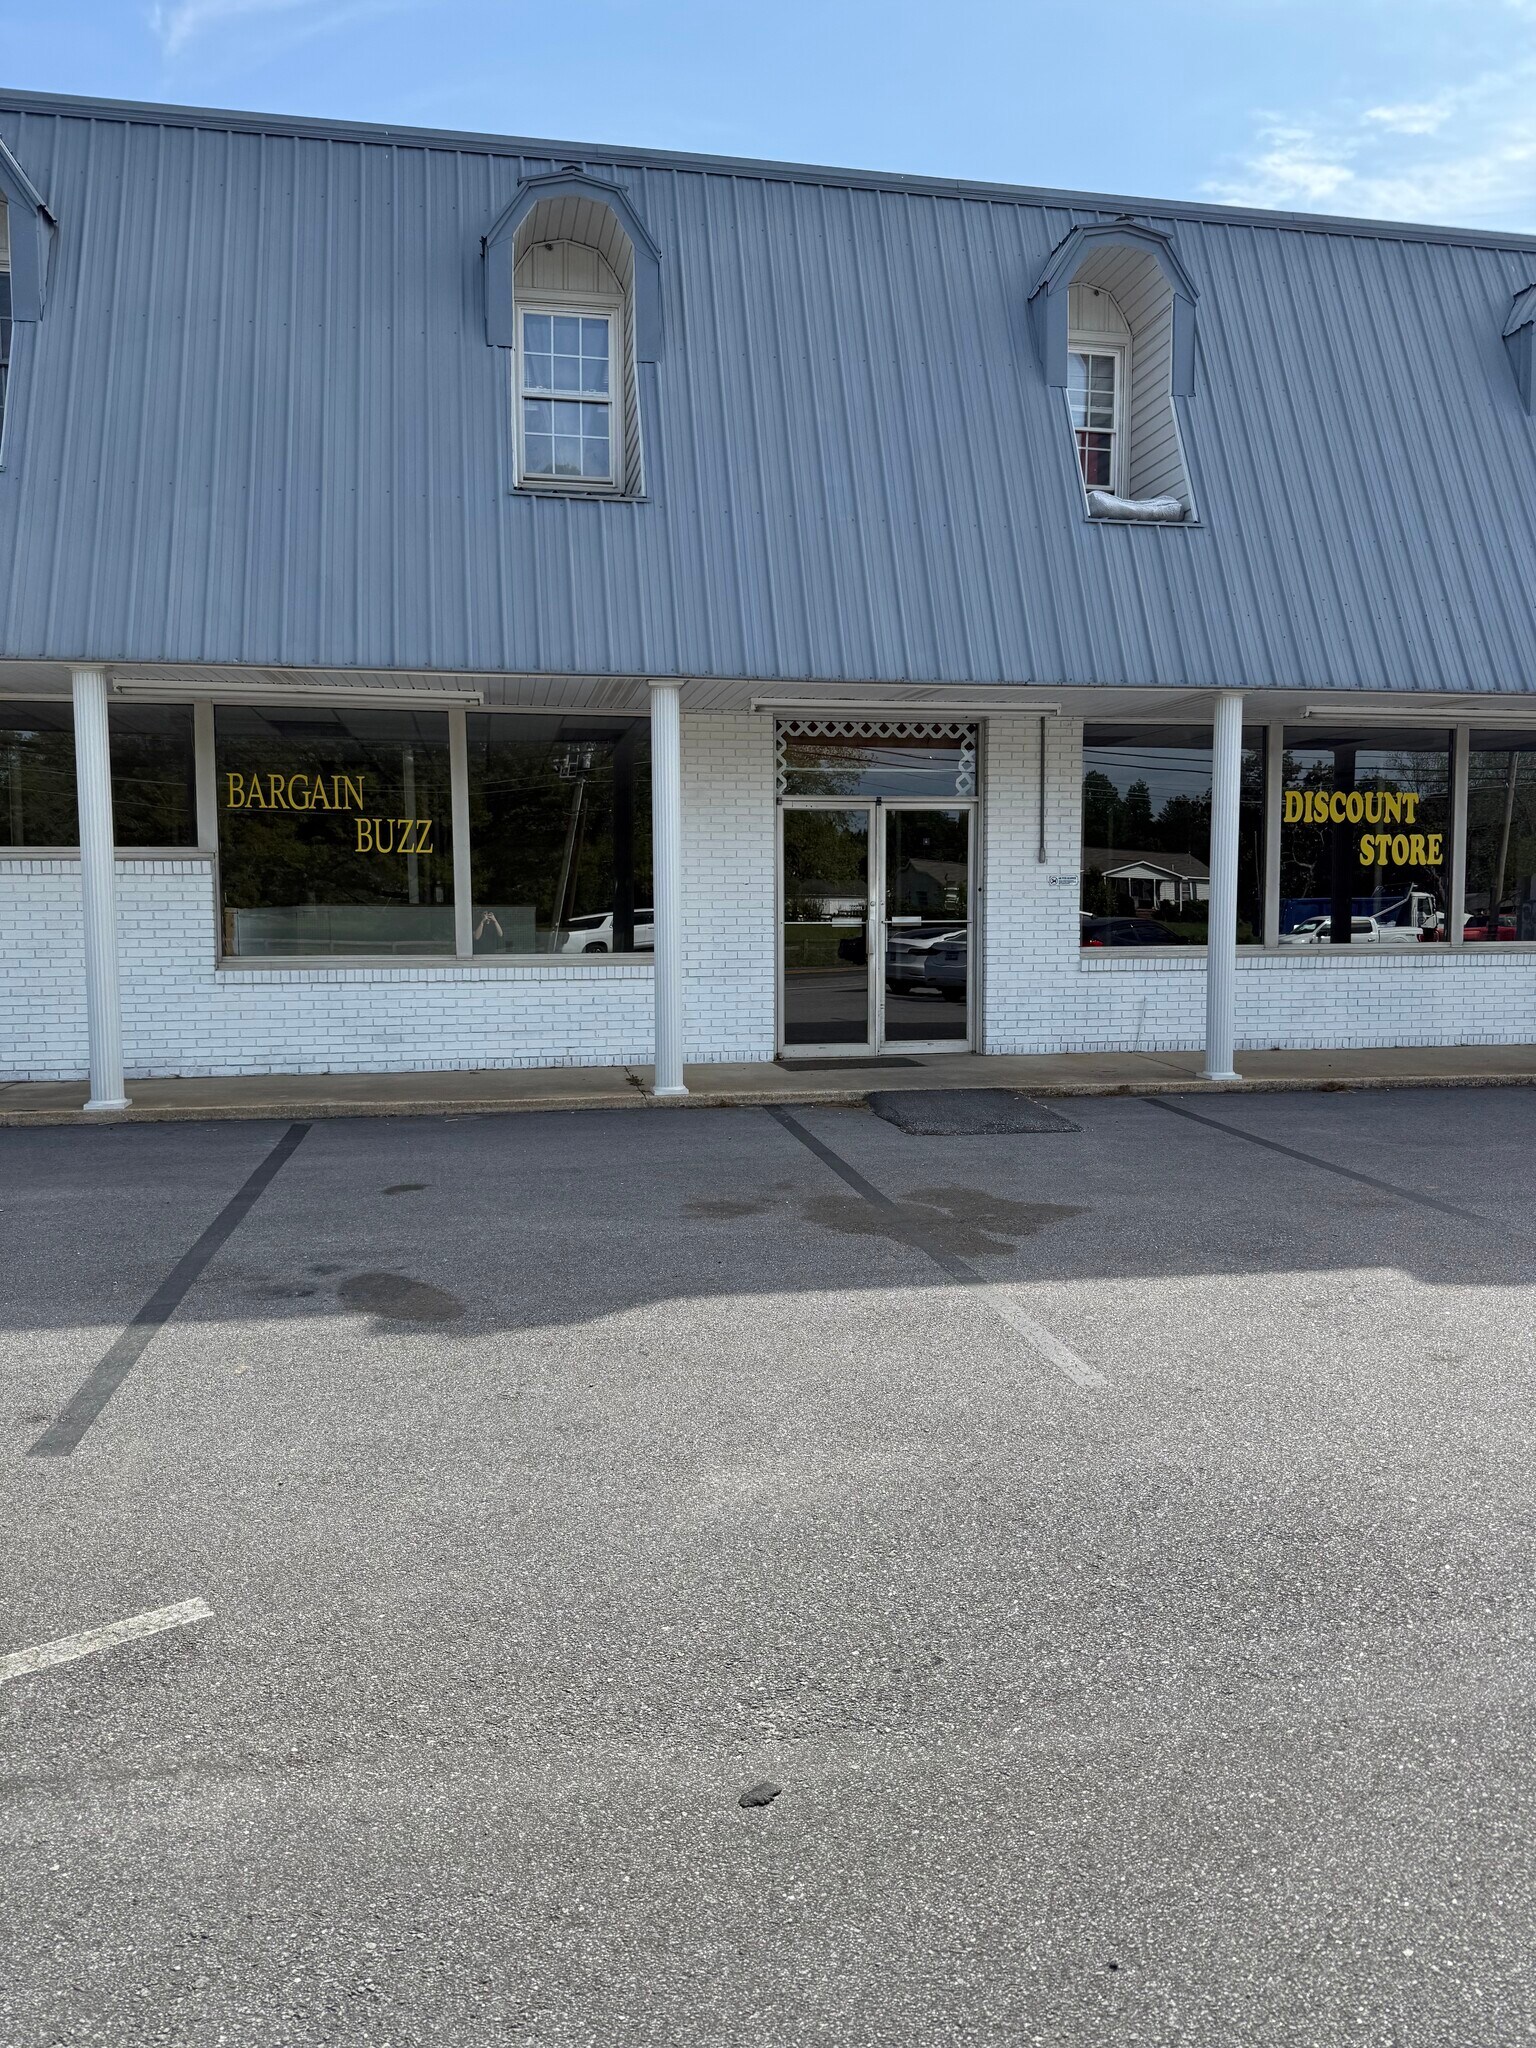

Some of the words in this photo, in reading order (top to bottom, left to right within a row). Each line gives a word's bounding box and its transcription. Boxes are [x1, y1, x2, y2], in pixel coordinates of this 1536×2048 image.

[226, 772, 365, 810] BARGAIN
[1284, 791, 1419, 823] DISCOUNT
[354, 818, 433, 853] BUZZ
[1359, 834, 1443, 865] STORE
